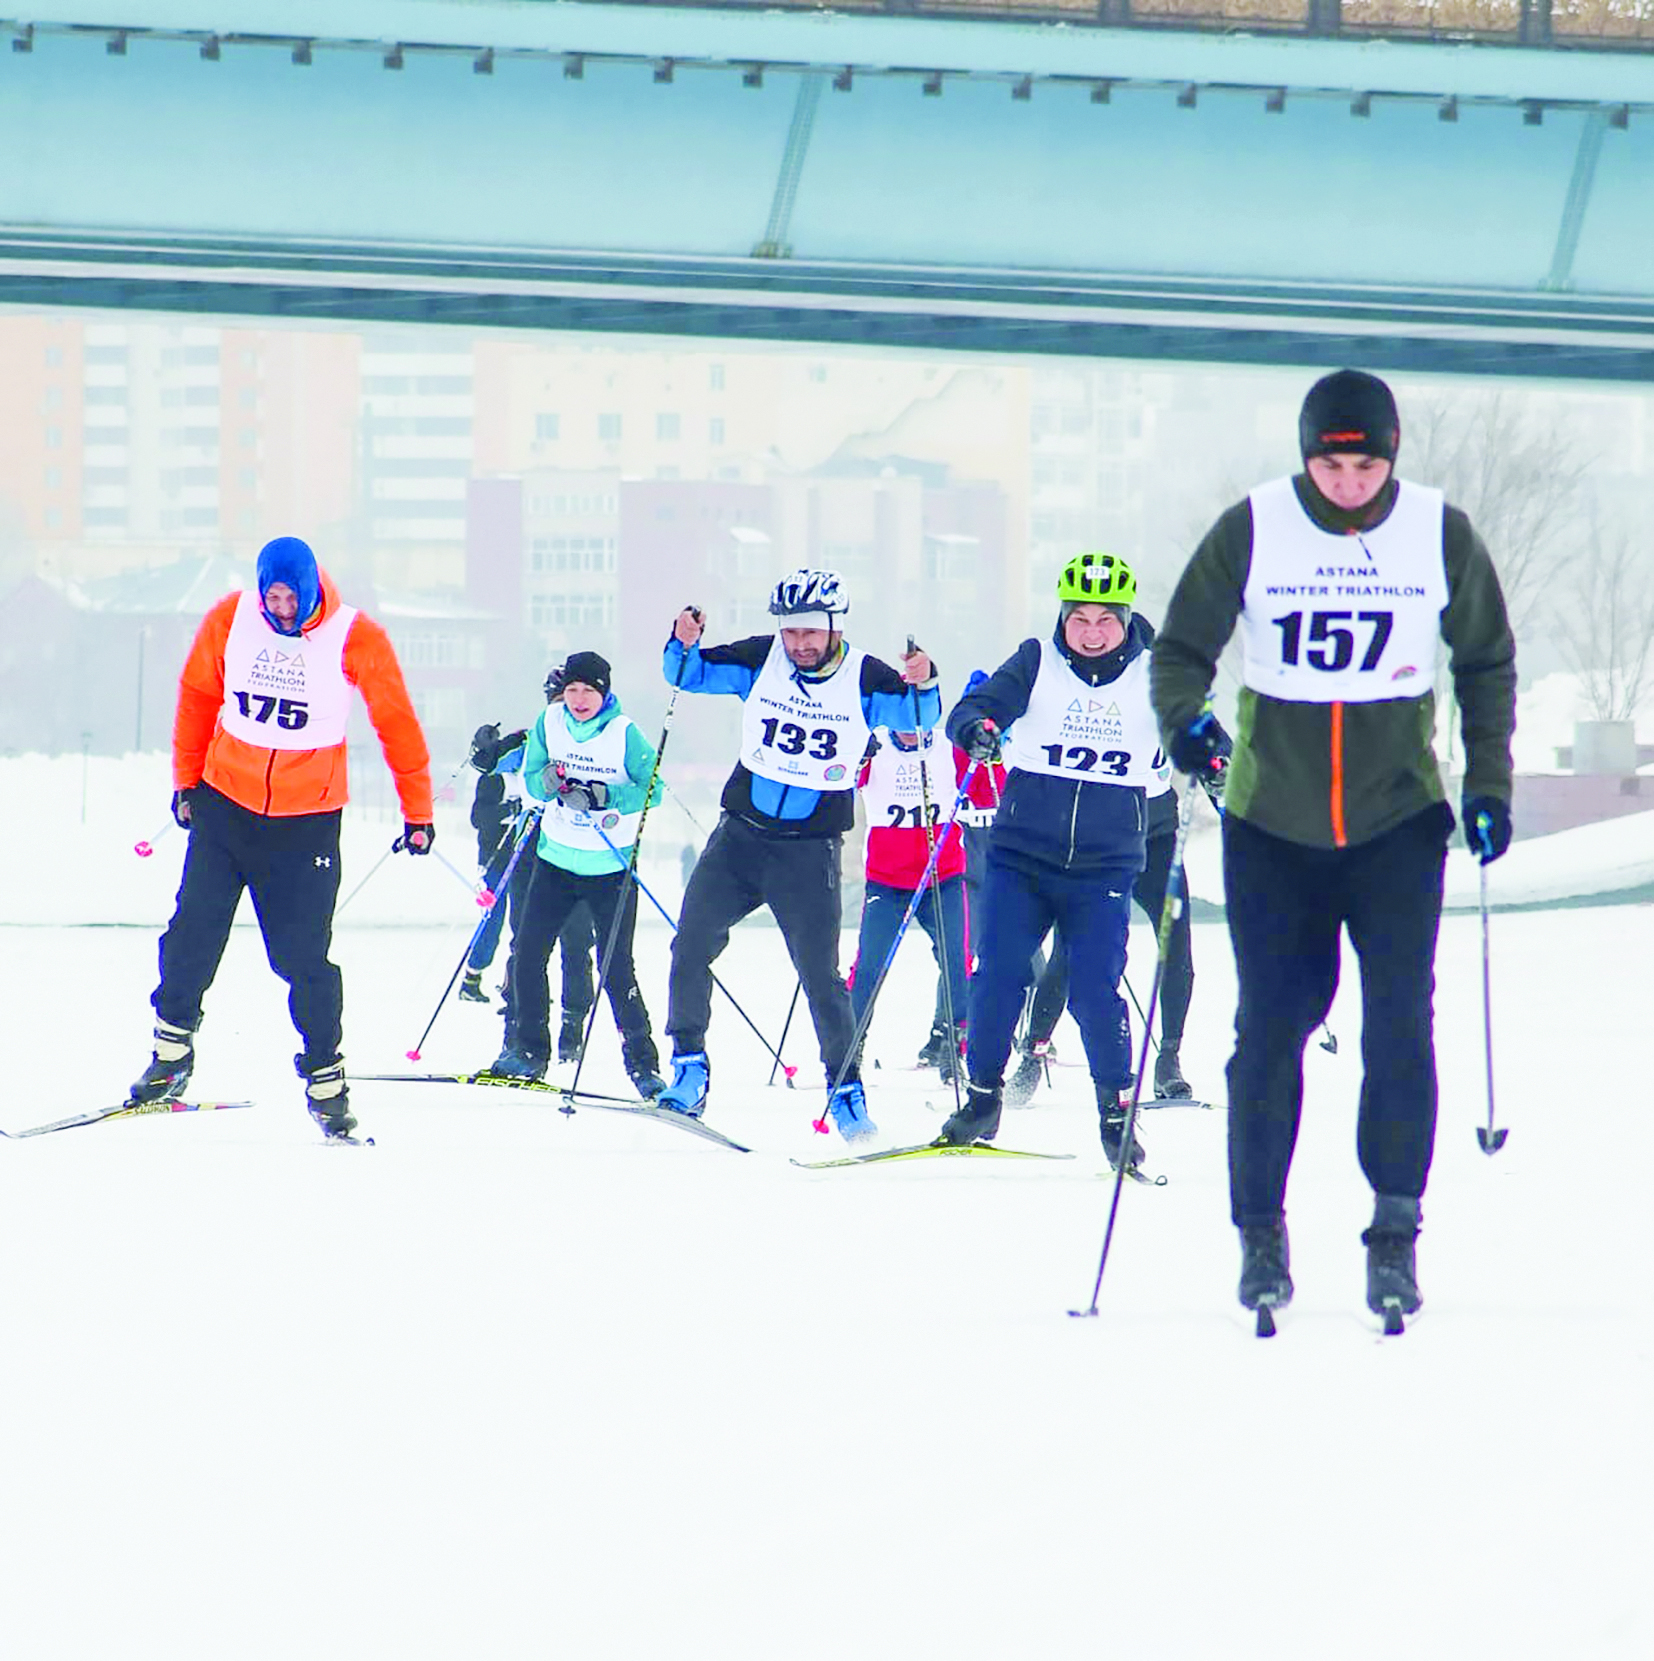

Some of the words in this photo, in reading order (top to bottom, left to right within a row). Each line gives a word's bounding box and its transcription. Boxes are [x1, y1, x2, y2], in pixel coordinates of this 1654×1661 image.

[1315, 567, 1379, 577] ASTANA
[1266, 586, 1329, 596] WINTER
[1337, 586, 1426, 597] TRIATHLON
[1271, 611, 1394, 672] 157
[252, 663, 305, 678] ASTANA
[250, 671, 305, 687] TRIATHLON
[760, 697, 794, 715] WINTER
[797, 710, 850, 722] TRIATHLON
[788, 695, 823, 709] ASTANA
[232, 691, 309, 730] 175
[1063, 714, 1122, 727] ASTANA
[1059, 731, 1122, 744] FEDERATION
[1062, 723, 1122, 737] TRIATHLON
[761, 717, 838, 761] 133
[1040, 744, 1131, 777] 123
[572, 764, 617, 774] TRIATHLON
[475, 1077, 561, 1095] FISCHER
